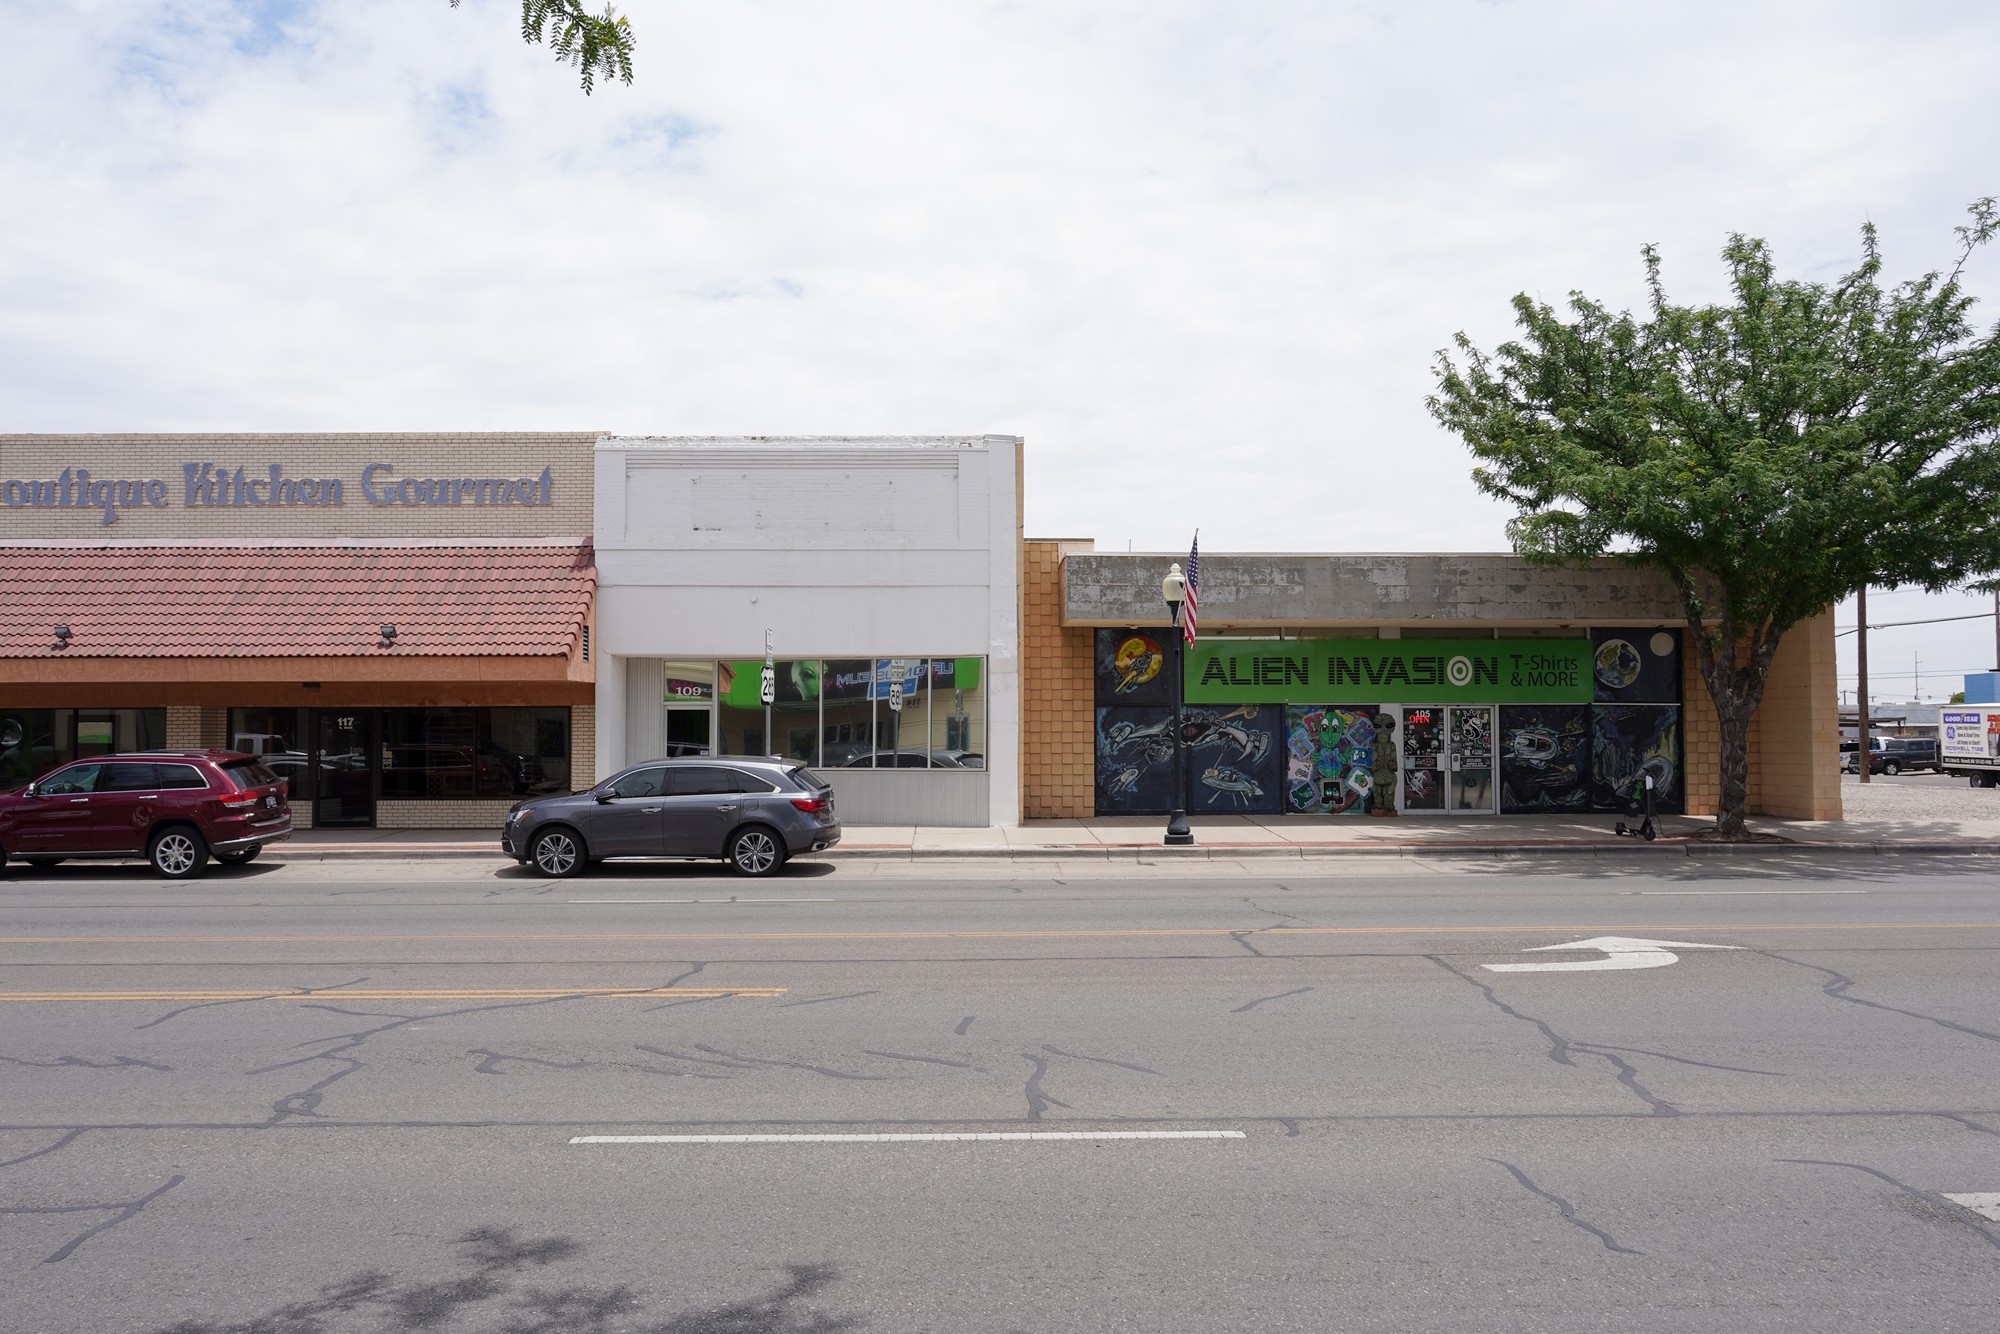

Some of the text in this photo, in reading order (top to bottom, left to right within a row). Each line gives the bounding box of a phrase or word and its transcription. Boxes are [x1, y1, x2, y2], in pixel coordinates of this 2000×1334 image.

[182, 462, 346, 507] Kitchen
[361, 463, 553, 507] Gourmet
[1509, 654, 1578, 670] T-Shirts
[1200, 655, 1498, 687] ALIEN INVASION
[1510, 671, 1578, 687] & MORE
[675, 686, 702, 696] 109
[337, 717, 354, 726] 117
[1409, 716, 1430, 724] OPEN
